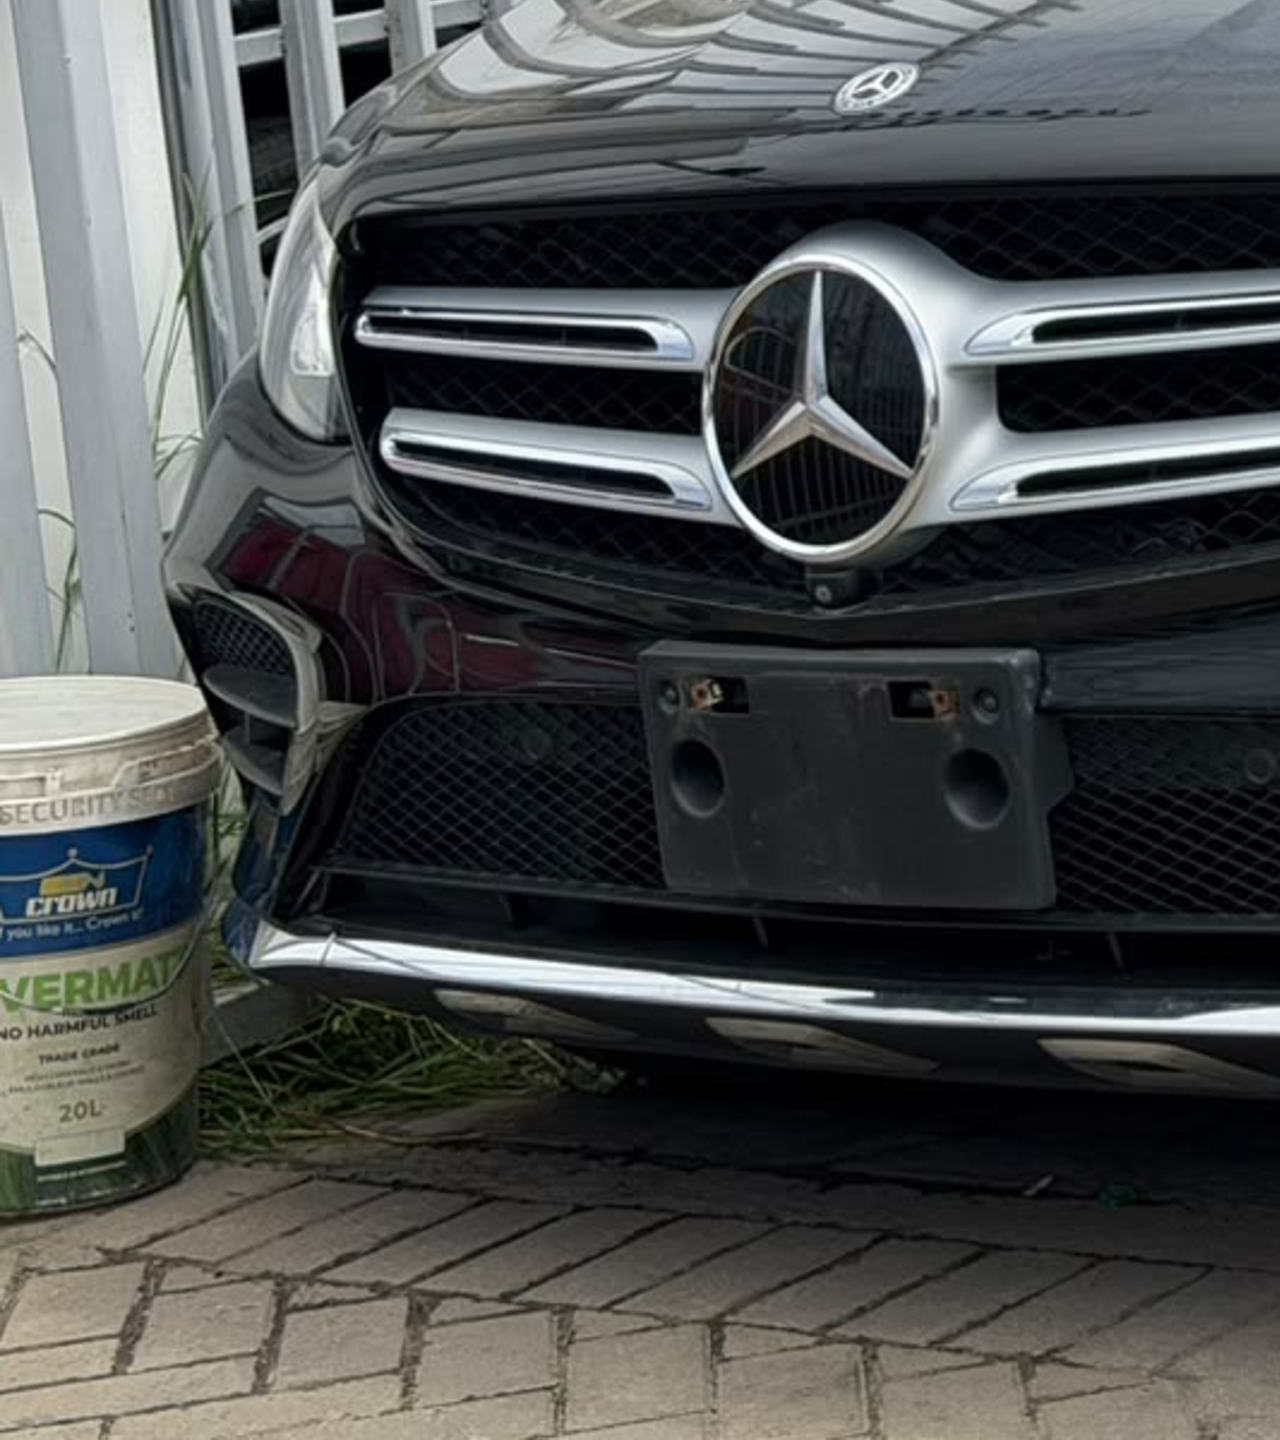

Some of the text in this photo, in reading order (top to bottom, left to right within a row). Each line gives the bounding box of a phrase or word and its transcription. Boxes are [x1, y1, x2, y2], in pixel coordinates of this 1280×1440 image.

[26, 887, 118, 917] crown
[27, 1014, 111, 1039] HARMFUL
[59, 1099, 103, 1122] 20L
